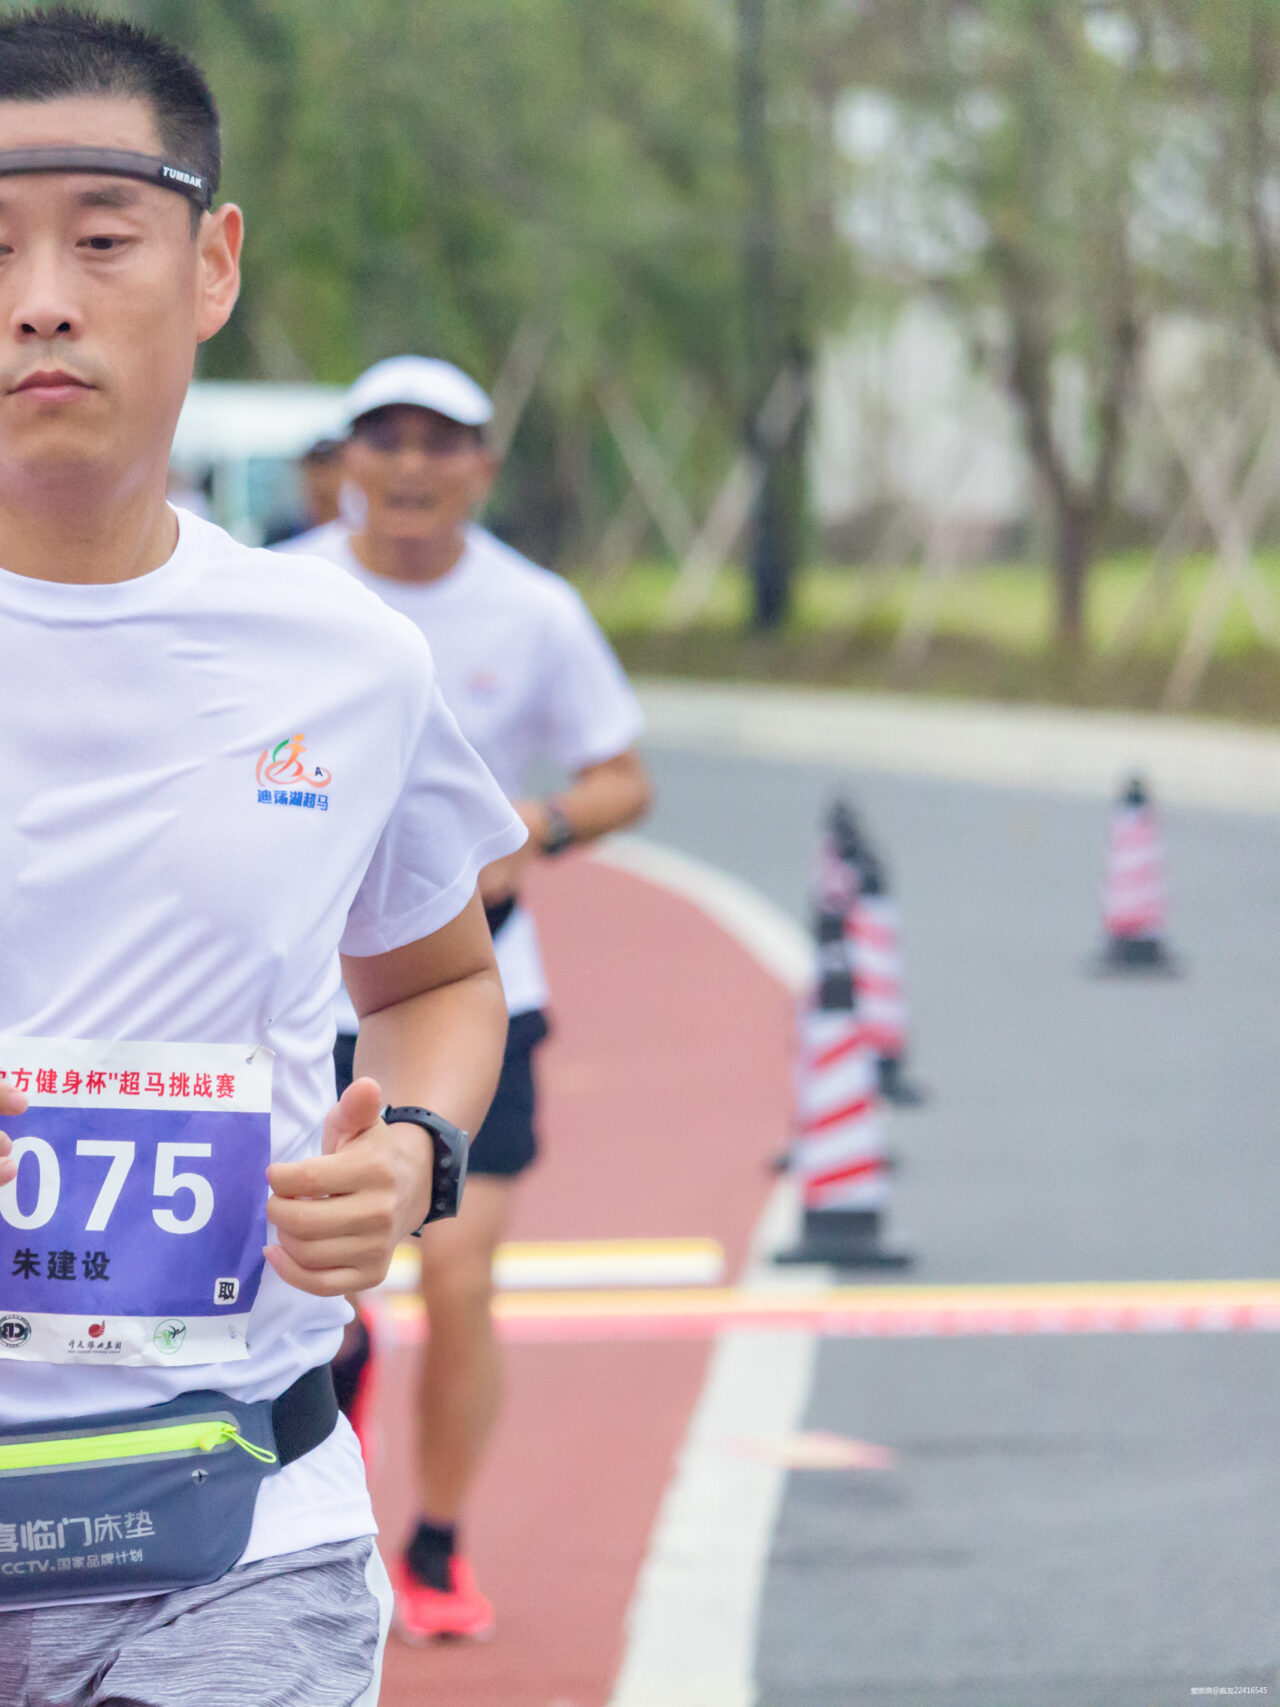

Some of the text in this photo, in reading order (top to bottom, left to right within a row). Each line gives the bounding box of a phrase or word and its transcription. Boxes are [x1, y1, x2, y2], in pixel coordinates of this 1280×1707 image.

[11, 1248, 111, 1281] 朱建设
[218, 1281, 235, 1301] 取
